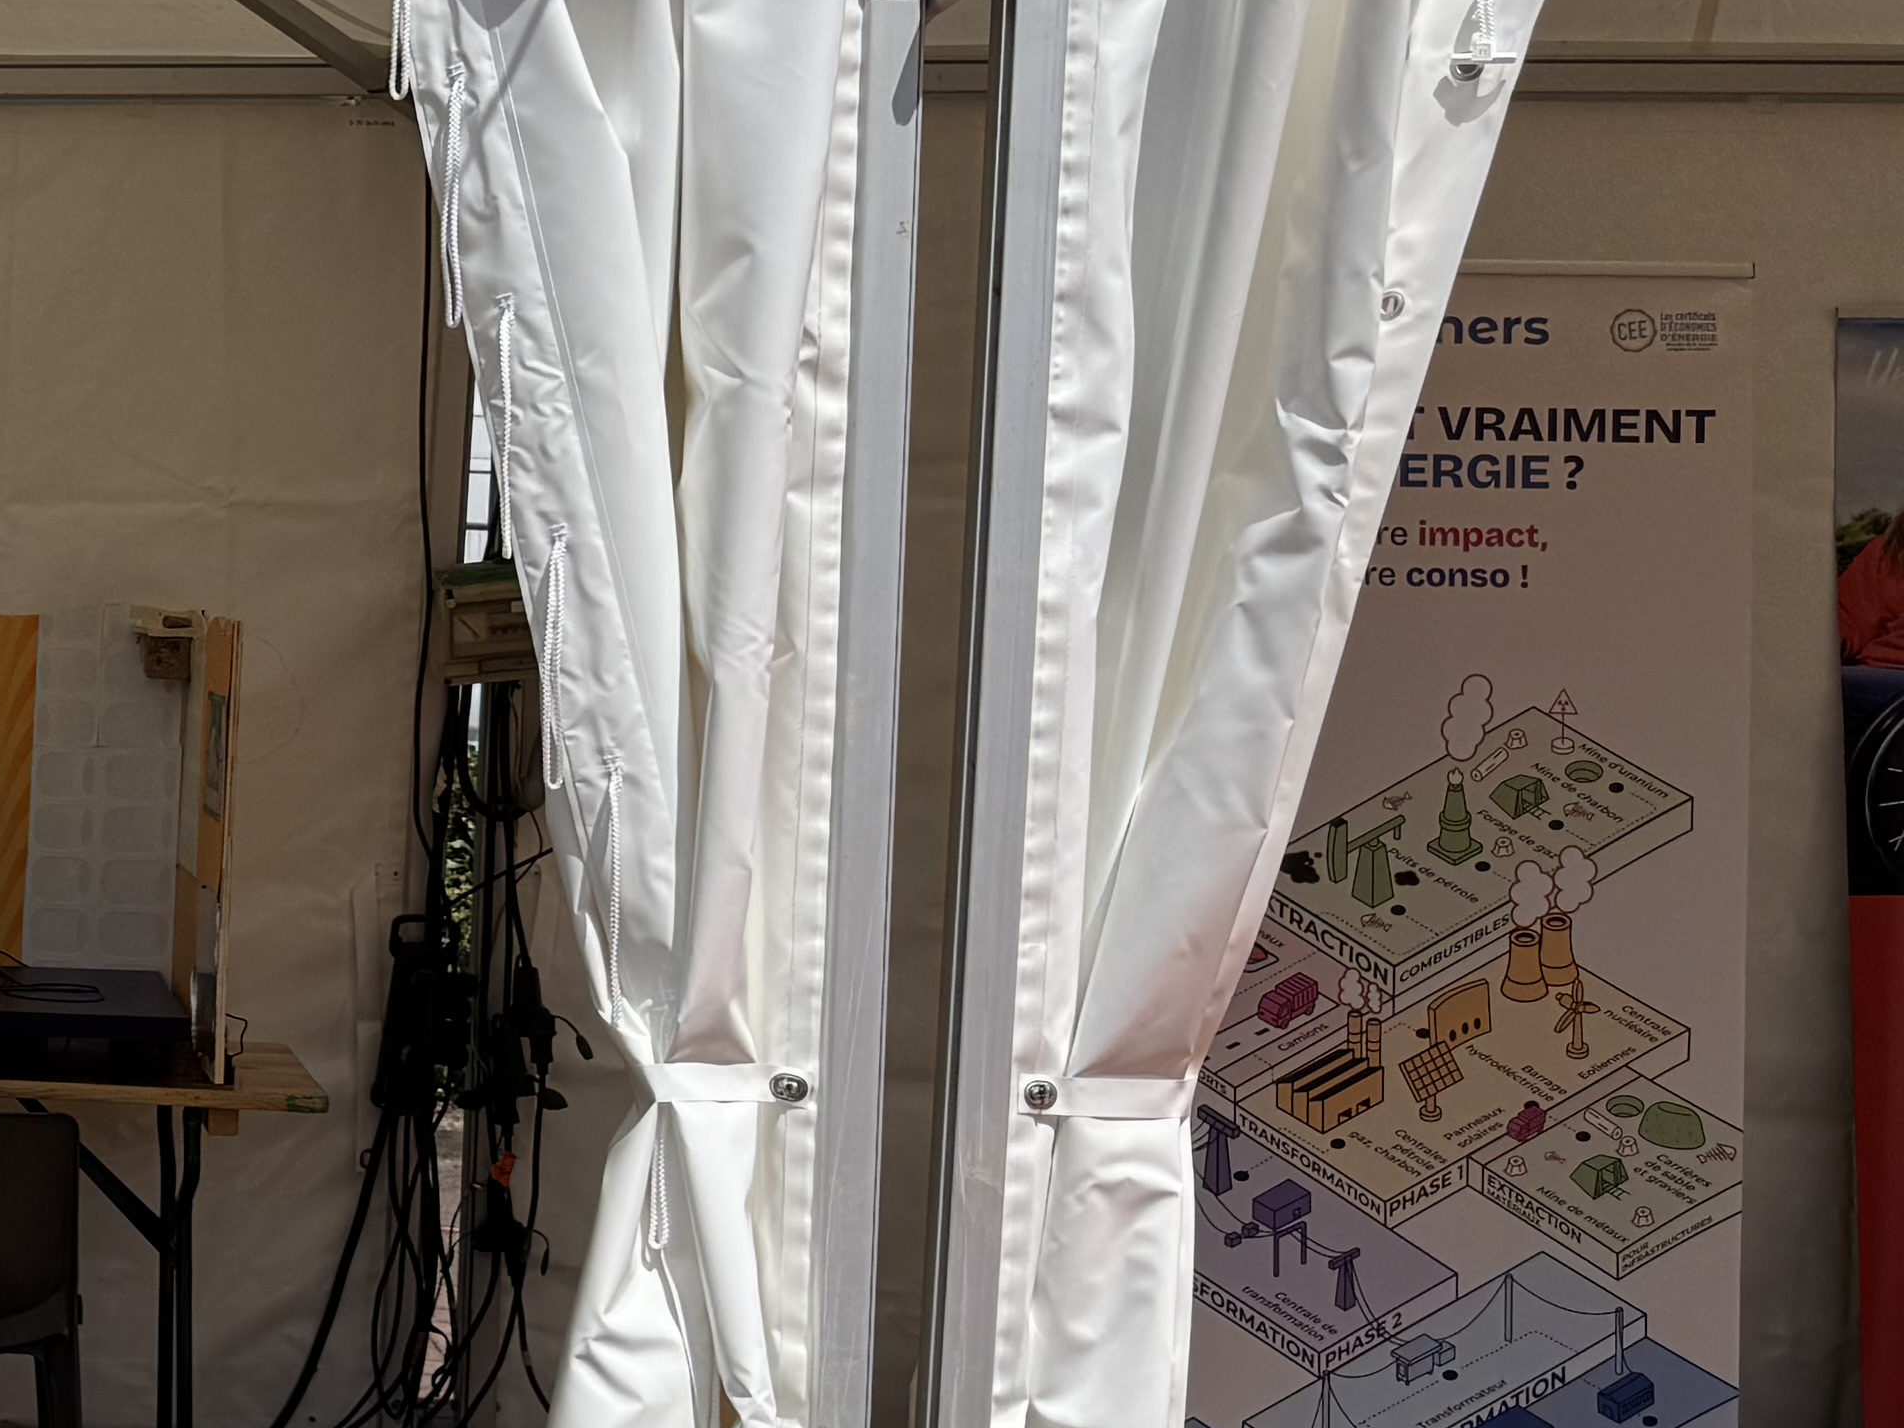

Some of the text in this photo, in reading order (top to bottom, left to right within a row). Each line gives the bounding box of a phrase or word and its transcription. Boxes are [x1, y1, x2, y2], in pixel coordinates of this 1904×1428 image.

[1617, 320, 1648, 341] CEE
[1437, 405, 1717, 444] VRAIMENT
[1398, 453, 1585, 491] ERGIE ?
[1418, 519, 1549, 553] impact,
[1405, 565, 1511, 588] conso
[1520, 563, 1530, 589] !
[1577, 742, 1670, 800] Mine d'uranium
[1530, 762, 1626, 824] Mine de charbon
[1476, 808, 1518, 838] Forage
[1518, 829, 1536, 845] de
[1387, 846, 1481, 905] Puits de pétrole
[1398, 913, 1510, 983] COMBUSTIBLES
[1276, 1022, 1330, 1052] Camions
[1603, 1006, 1660, 1043] nucléaire
[1620, 1003, 1673, 1037] Centrale
[1465, 1043, 1556, 1104] hydroélectrique
[1519, 1063, 1569, 1097] Barrage
[1442, 1105, 1507, 1141] Panneaux
[1456, 1119, 1505, 1149] solaires
[1238, 1112, 1466, 1218] TRANSFORMATION PHASE 1
[1374, 1141, 1423, 1179] charbon
[1390, 1141, 1436, 1172] pétrole
[1394, 1128, 1449, 1166] Centrales
[1633, 1165, 1698, 1205] et graviers
[1644, 1160, 1697, 1191] de sable
[1656, 1153, 1713, 1189] Carrières
[1487, 1175, 1582, 1245] EXTRACTION
[1535, 1184, 1631, 1244] Mine de métaux
[1241, 1284, 1325, 1343] transformation
[1275, 1290, 1339, 1336] Centrale de
[1325, 1320, 1387, 1369] PHASE
[1392, 1311, 1403, 1330] 2
